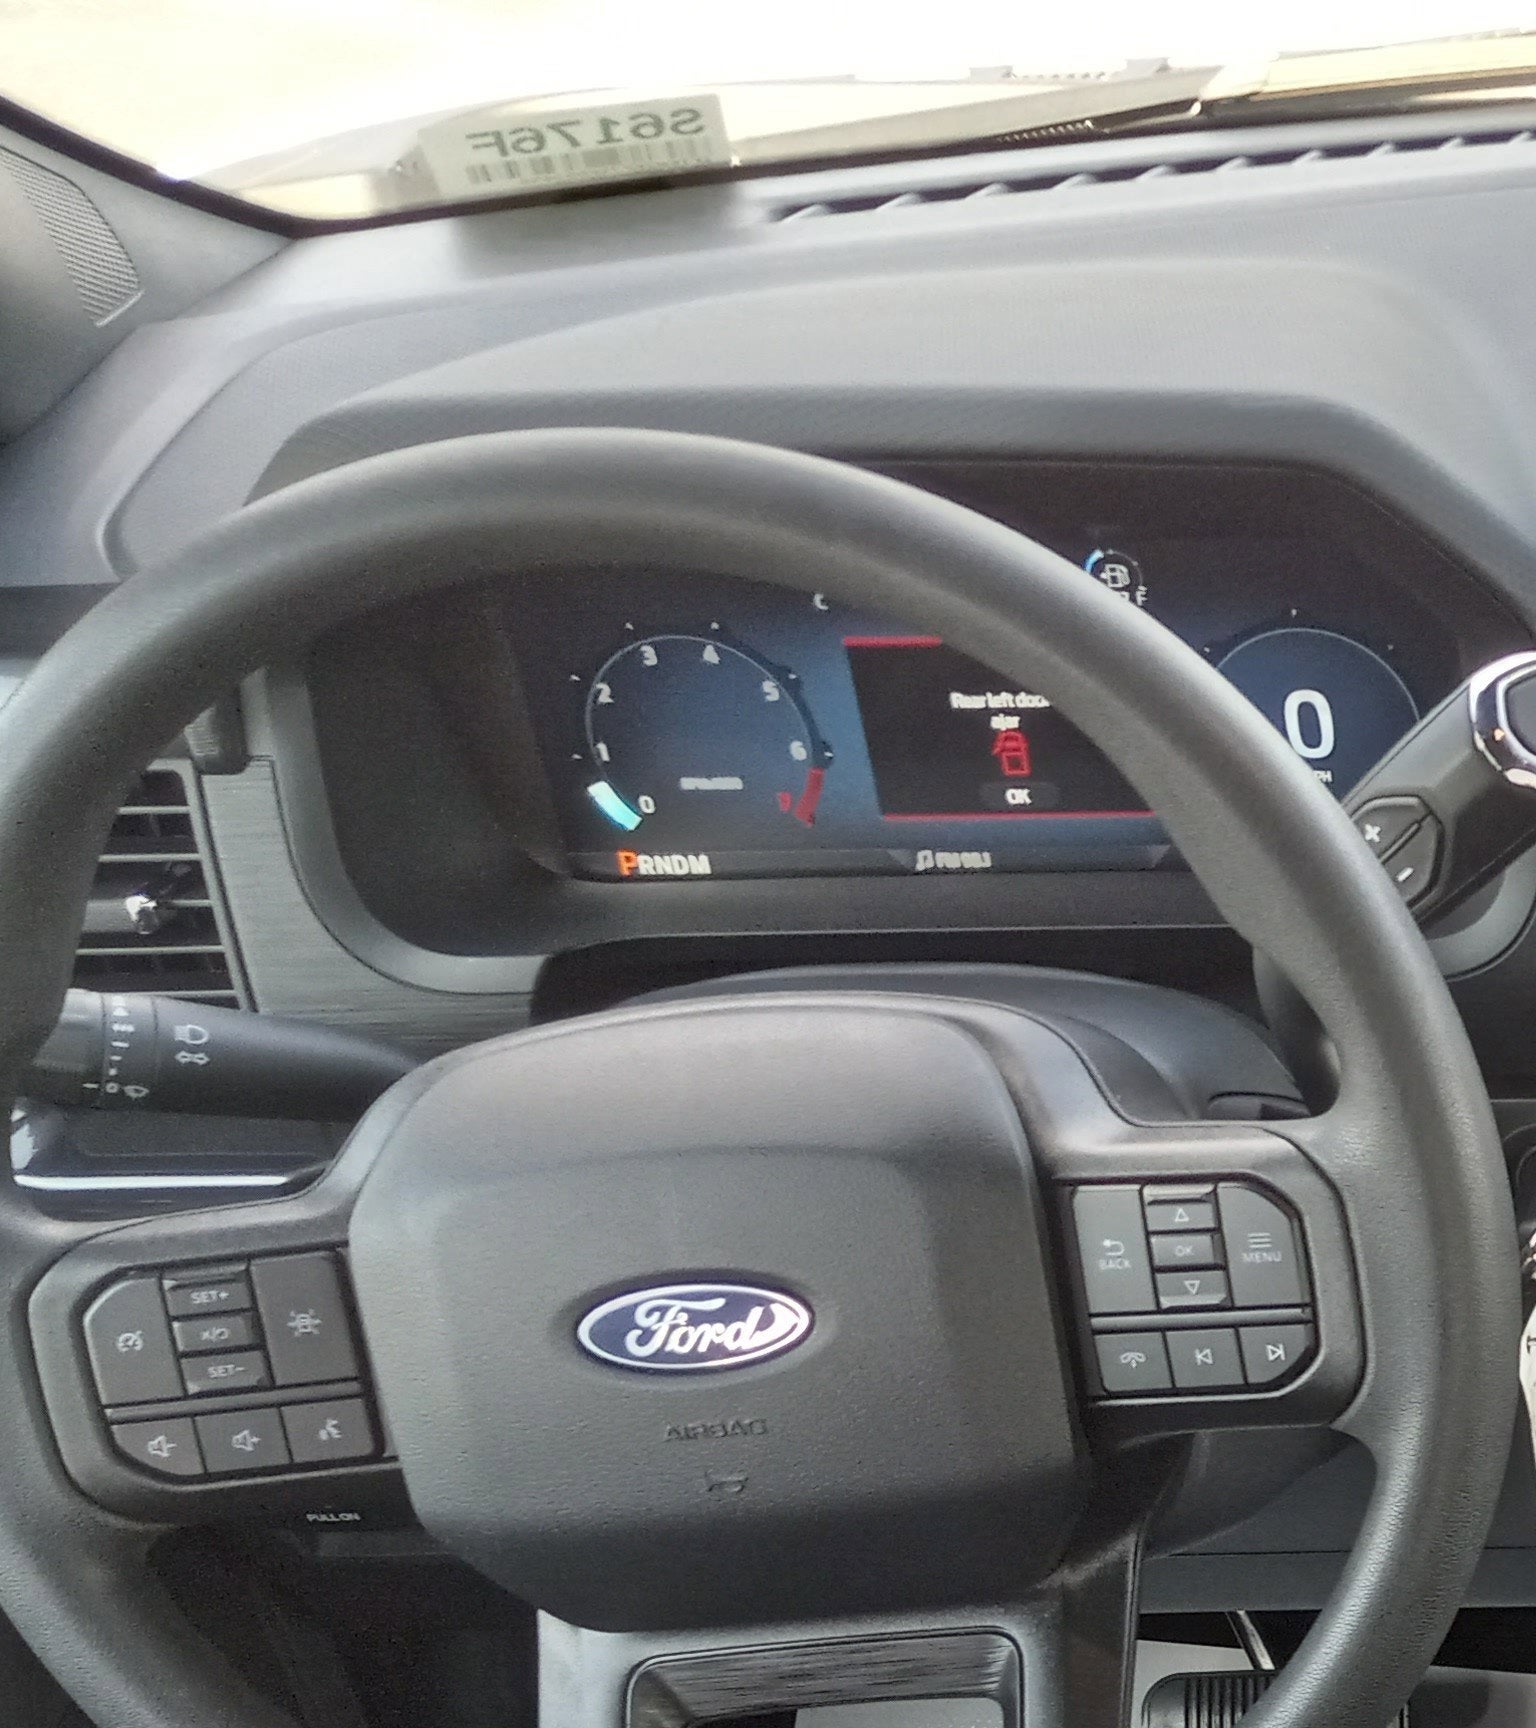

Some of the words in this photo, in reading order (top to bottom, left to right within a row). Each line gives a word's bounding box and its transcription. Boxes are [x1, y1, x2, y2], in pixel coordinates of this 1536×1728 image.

[640, 645, 658, 666] 3
[703, 645, 720, 665] 4
[596, 683, 614, 704] 2
[762, 680, 780, 701] 5
[1284, 689, 1335, 759] 0
[790, 740, 808, 761] 6
[638, 795, 656, 814] 0
[1005, 788, 1032, 804] OK
[1174, 1245, 1194, 1257] OK
[1241, 1252, 1282, 1263] MENU
[1099, 1258, 1132, 1270] BACK
[625, 1297, 795, 1358] Ford
[664, 1418, 768, 1442] AIRBAG
